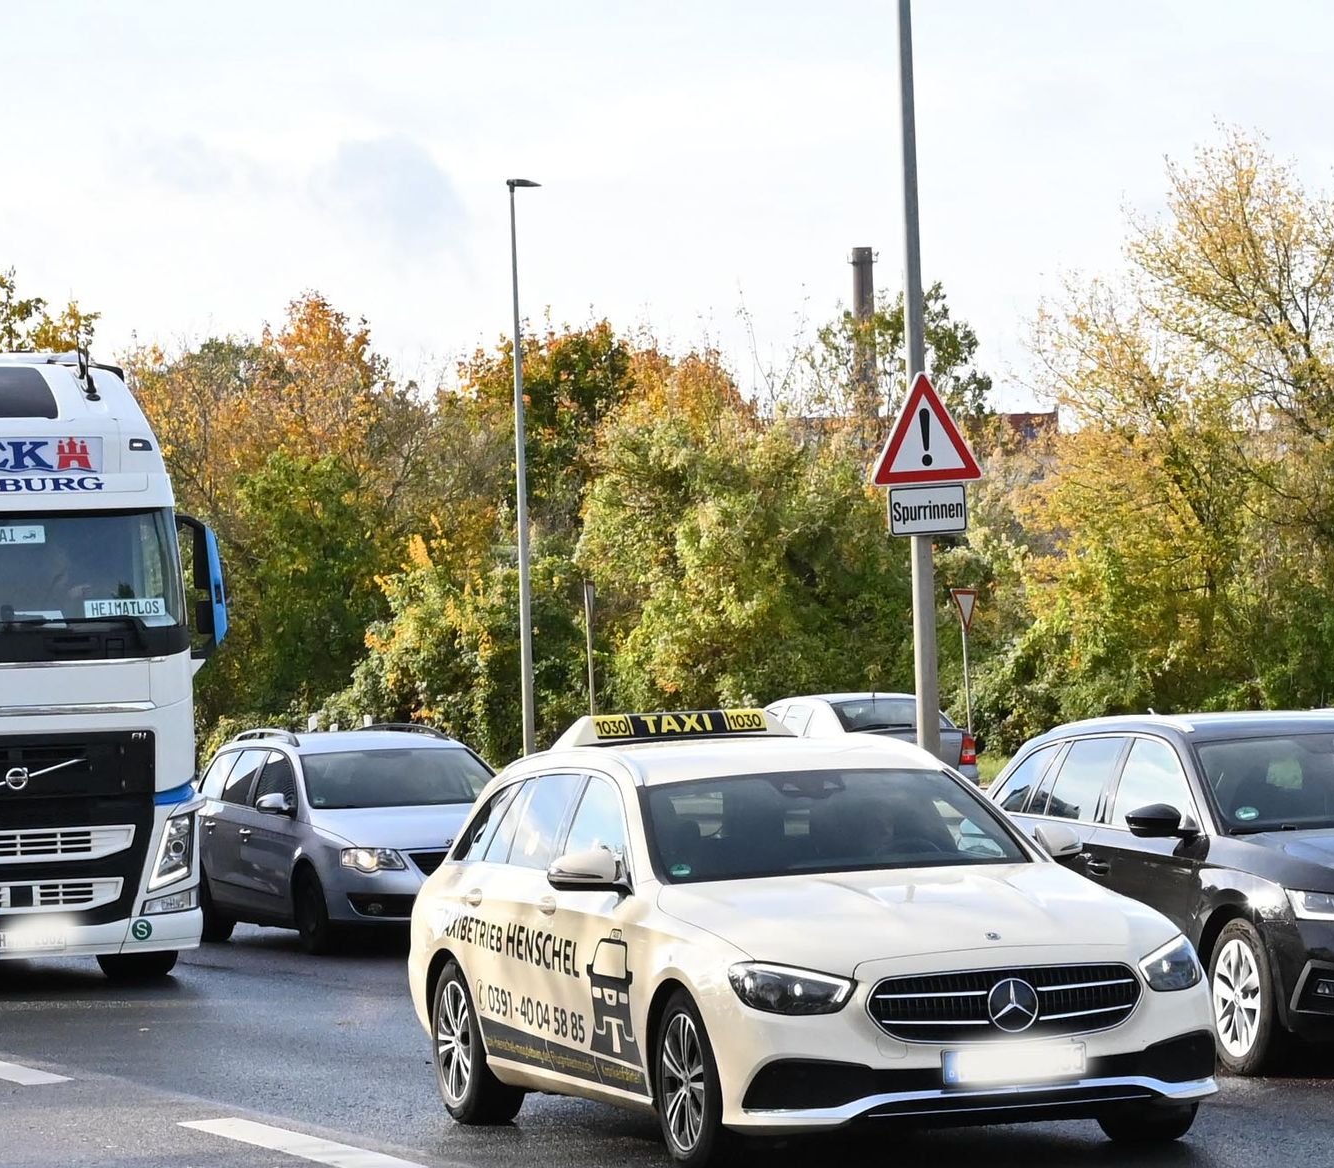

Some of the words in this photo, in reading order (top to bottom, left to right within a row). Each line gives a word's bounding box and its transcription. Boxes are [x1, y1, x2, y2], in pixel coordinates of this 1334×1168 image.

[893, 500, 963, 525] Spurrinnen
[91, 601, 160, 616] HEIMATLOS
[596, 721, 627, 735] 1030
[640, 714, 713, 734] TAXI
[731, 714, 763, 728] 1030
[506, 921, 580, 978] HENSCHEL
[487, 985, 514, 1019] 0391
[553, 1007, 568, 1037] 58
[571, 1012, 585, 1043] 85
